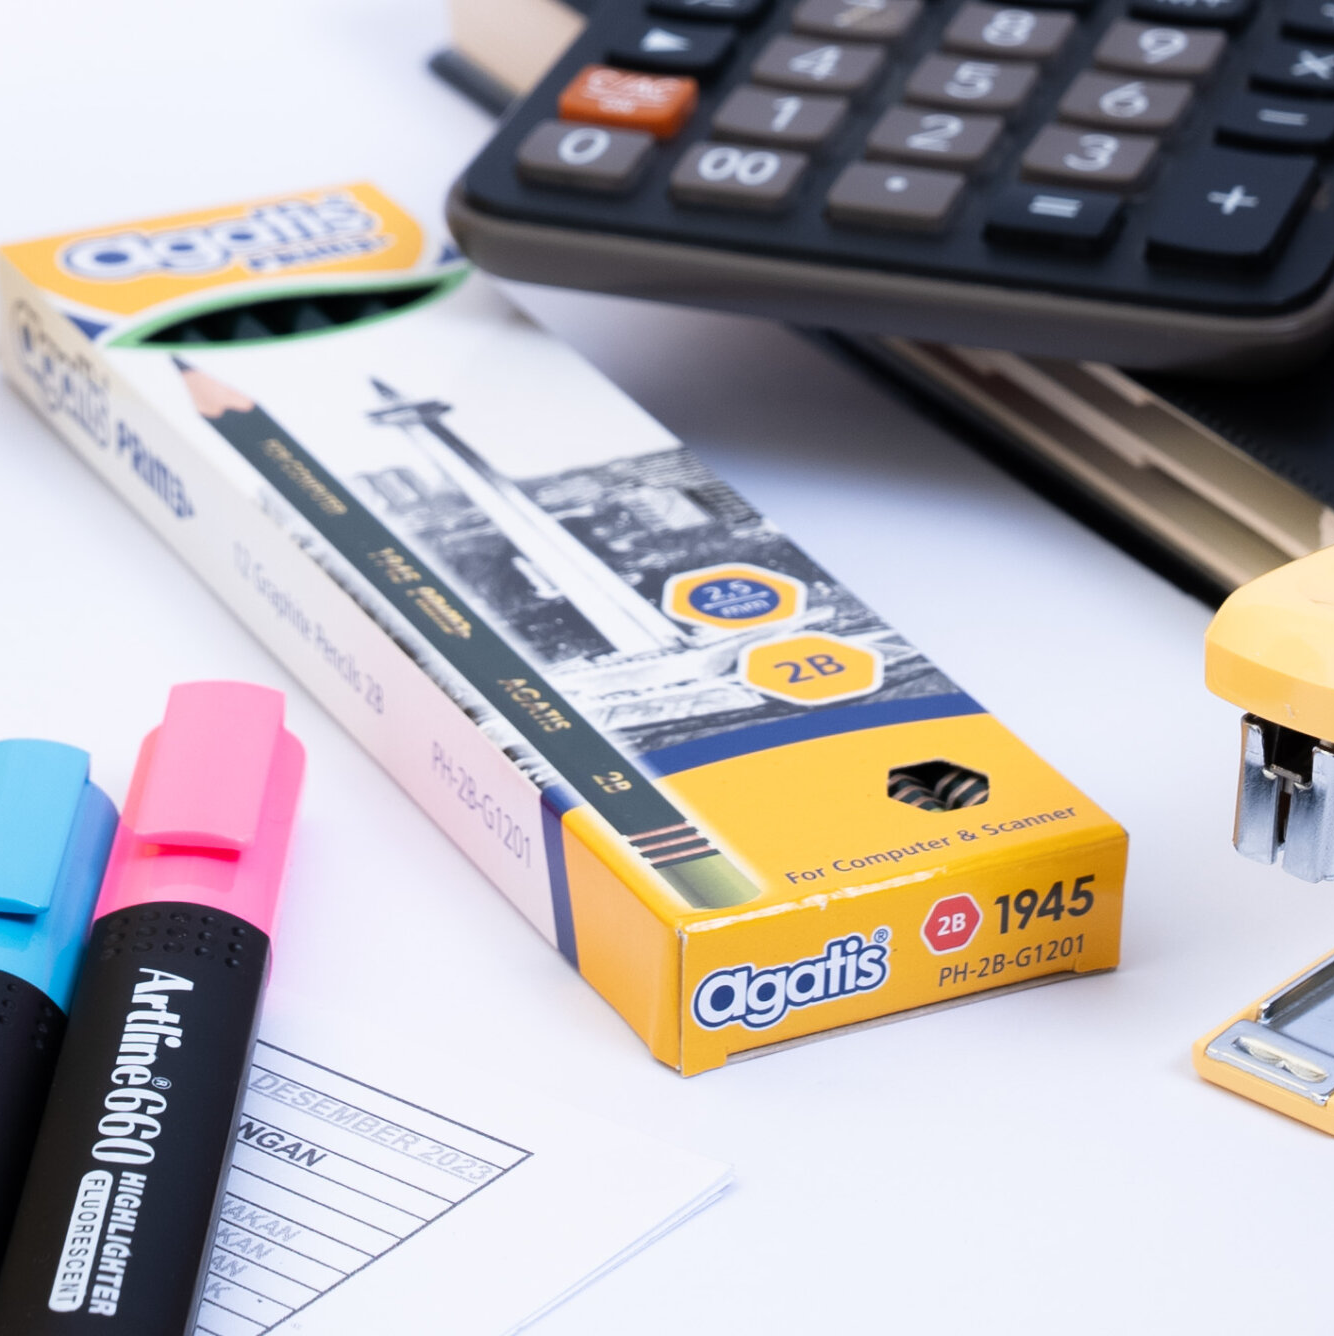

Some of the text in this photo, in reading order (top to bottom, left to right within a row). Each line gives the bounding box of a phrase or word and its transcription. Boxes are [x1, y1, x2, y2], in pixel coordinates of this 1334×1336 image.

[789, 45, 842, 80] 4
[1139, 27, 1187, 64] 9
[944, 61, 1001, 99] 5
[771, 96, 802, 132] 1
[1099, 82, 1148, 117] 6
[906, 114, 963, 152] 2
[698, 146, 780, 186] 00
[1064, 134, 1119, 171] 3
[774, 653, 846, 684] 2B
[497, 678, 572, 734] AGATIS
[592, 771, 632, 794] 2B
[785, 866, 826, 886] For
[833, 833, 953, 873] Computer
[982, 805, 1077, 837] Scanner
[994, 875, 1095, 935] 1945
[937, 912, 966, 937] 2B
[938, 933, 1084, 987] PH-2B-G1201
[250, 1074, 494, 1181] DESEMBER 2023
[55, 1177, 106, 1305] FLUORESCENT
[87, 1171, 148, 1317] HIGHLIGHTER
